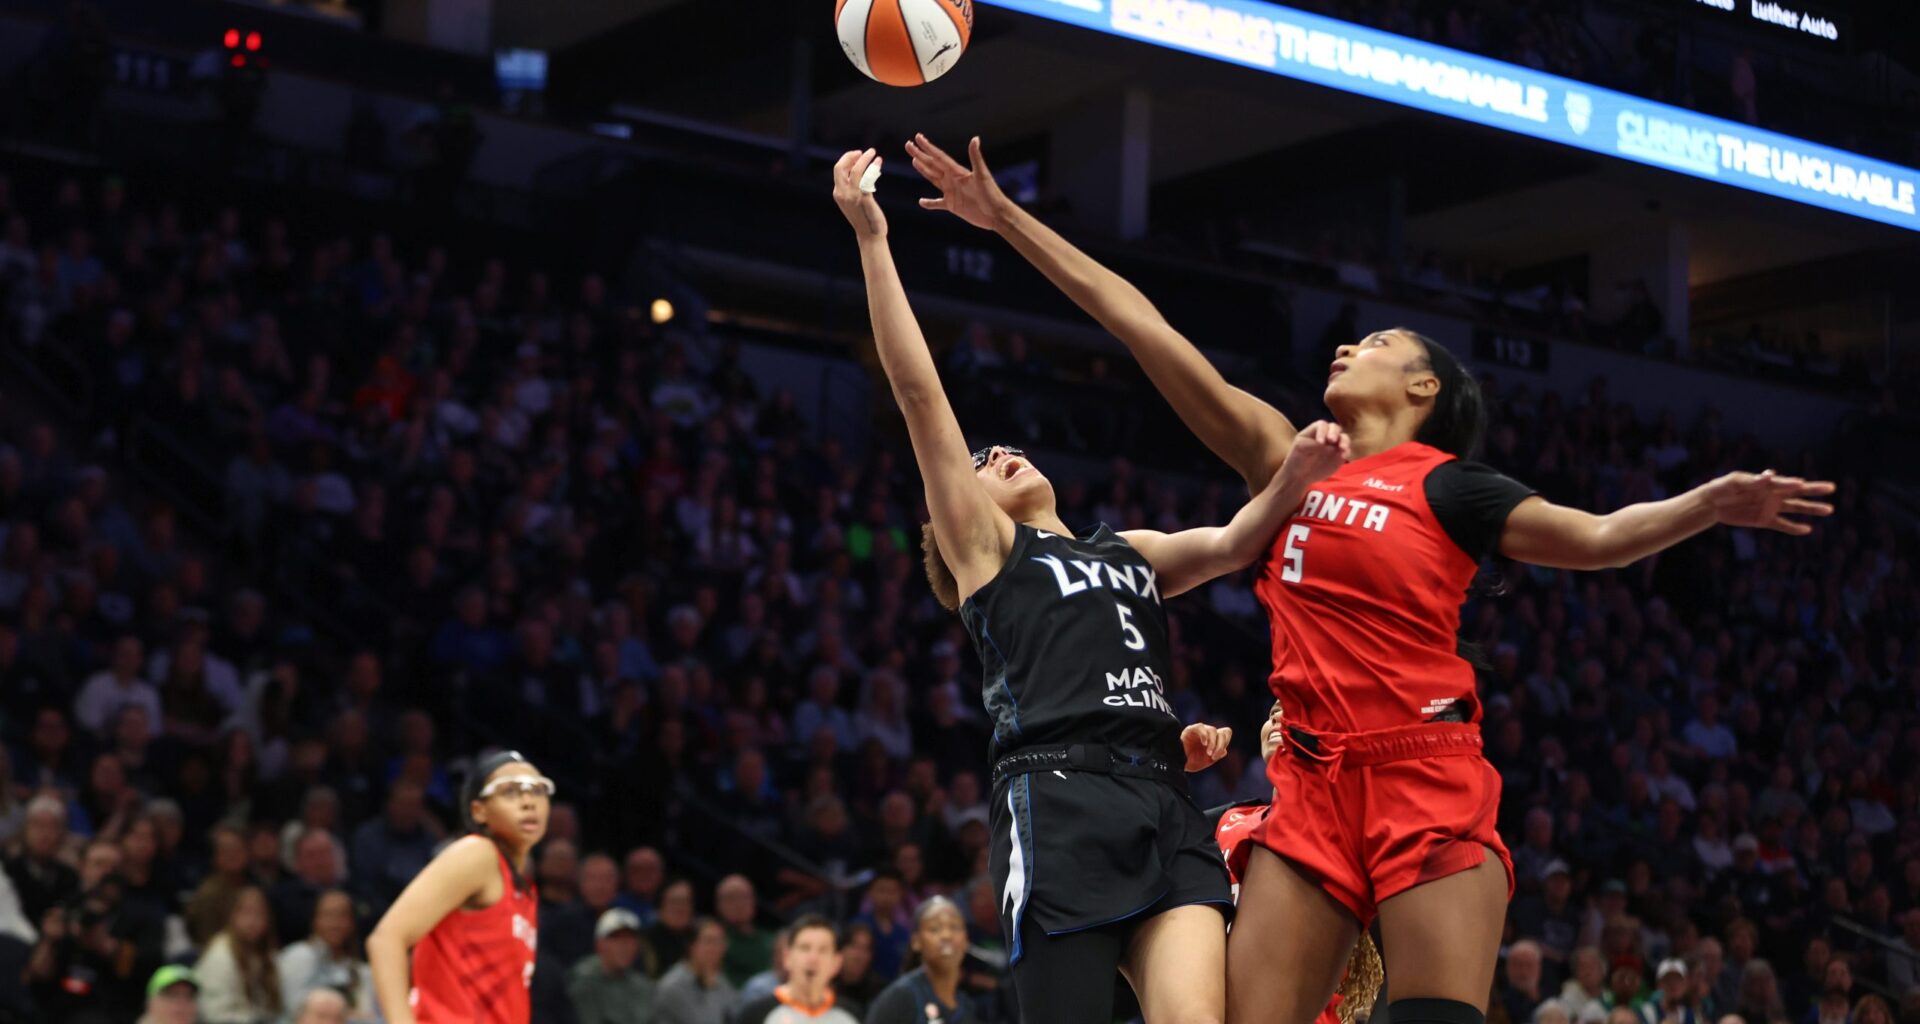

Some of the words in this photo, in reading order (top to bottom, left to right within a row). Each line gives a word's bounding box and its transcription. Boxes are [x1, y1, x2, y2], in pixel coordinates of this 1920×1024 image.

[1751, 0, 1799, 29] Luther
[1800, 11, 1838, 40] Auto
[1616, 110, 1719, 166] CURING
[1717, 133, 1771, 179] THE
[1770, 146, 1916, 214] UNCURABLE
[1300, 490, 1390, 532] ANTA
[1031, 553, 1161, 606] LYNX
[1281, 524, 1311, 584] 5
[1115, 602, 1146, 651] 5
